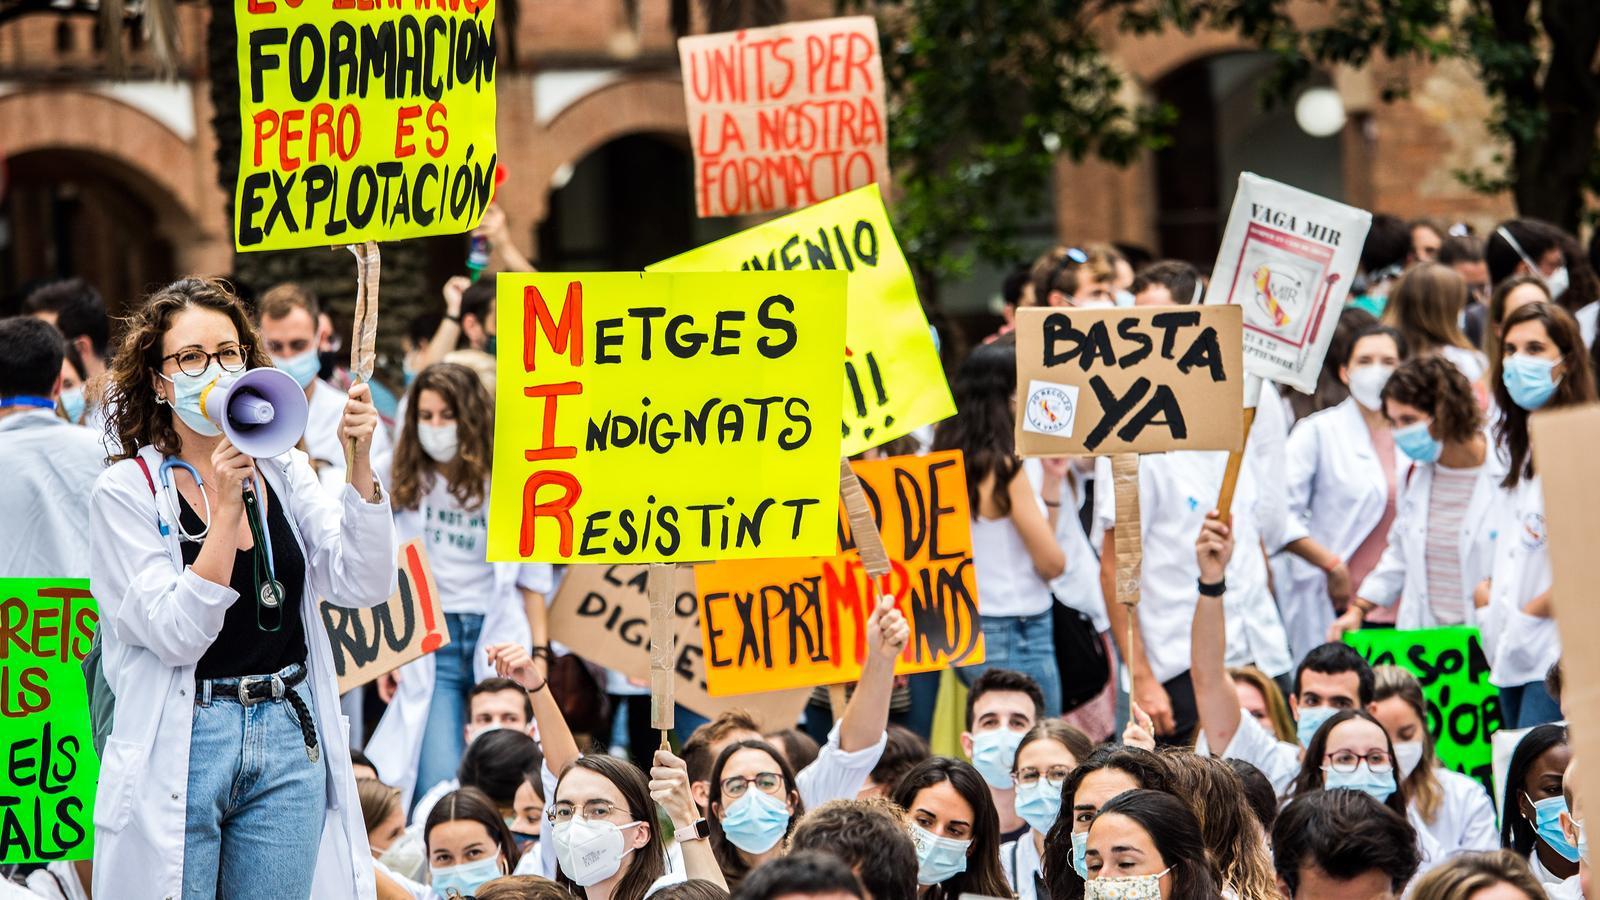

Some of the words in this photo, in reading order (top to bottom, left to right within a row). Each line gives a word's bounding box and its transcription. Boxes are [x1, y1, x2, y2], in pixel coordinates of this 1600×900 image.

[805, 32, 875, 94] PER
[253, 103, 361, 172] PERO
[395, 101, 450, 158] ES
[698, 112, 746, 158] LA
[756, 97, 883, 152] NOSTRA
[239, 144, 498, 246] EXPLOTACIÓN
[1251, 202, 1297, 232] VAGA
[1303, 221, 1342, 247] MIR
[1043, 310, 1227, 383] BASTA
[1083, 374, 1188, 452] YA
[893, 459, 965, 561] DE
[8, 721, 80, 795] ELS
